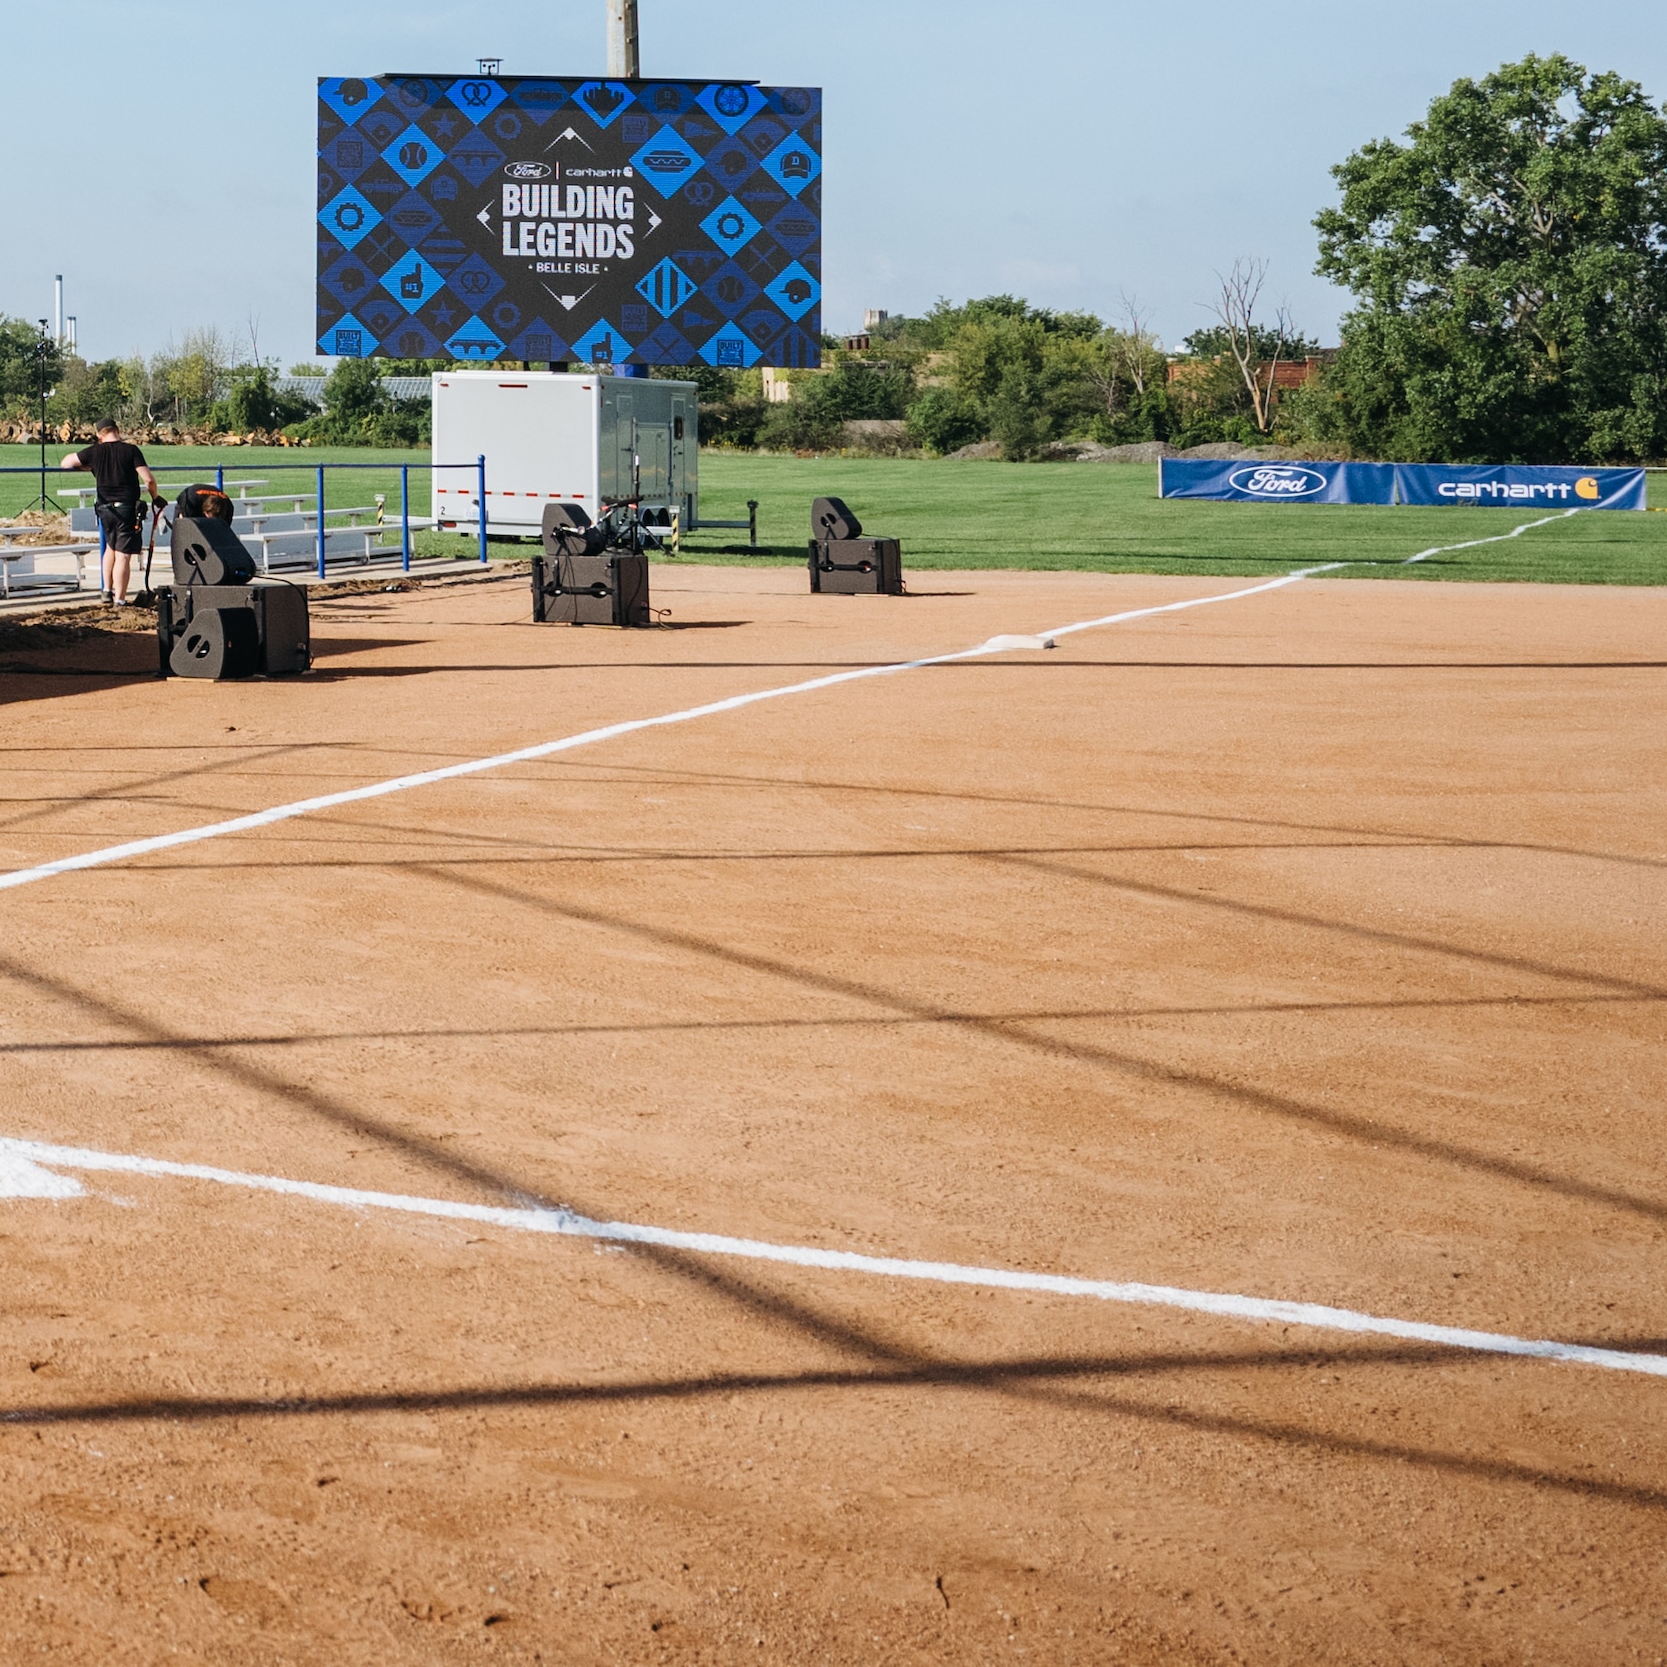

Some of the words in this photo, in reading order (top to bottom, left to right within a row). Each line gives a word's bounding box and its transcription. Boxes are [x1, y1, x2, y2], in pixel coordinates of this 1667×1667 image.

[513, 164, 542, 176] Ford
[566, 168, 622, 177] carhartt
[502, 184, 634, 220] BUILDING
[502, 221, 635, 259] LEGENDS
[536, 262, 571, 273] BELLE
[575, 263, 600, 274] ISLE
[405, 283, 419, 293] #1
[1248, 470, 1307, 492] Ford
[1438, 481, 1571, 499] carhartt
[440, 506, 446, 515] 2
